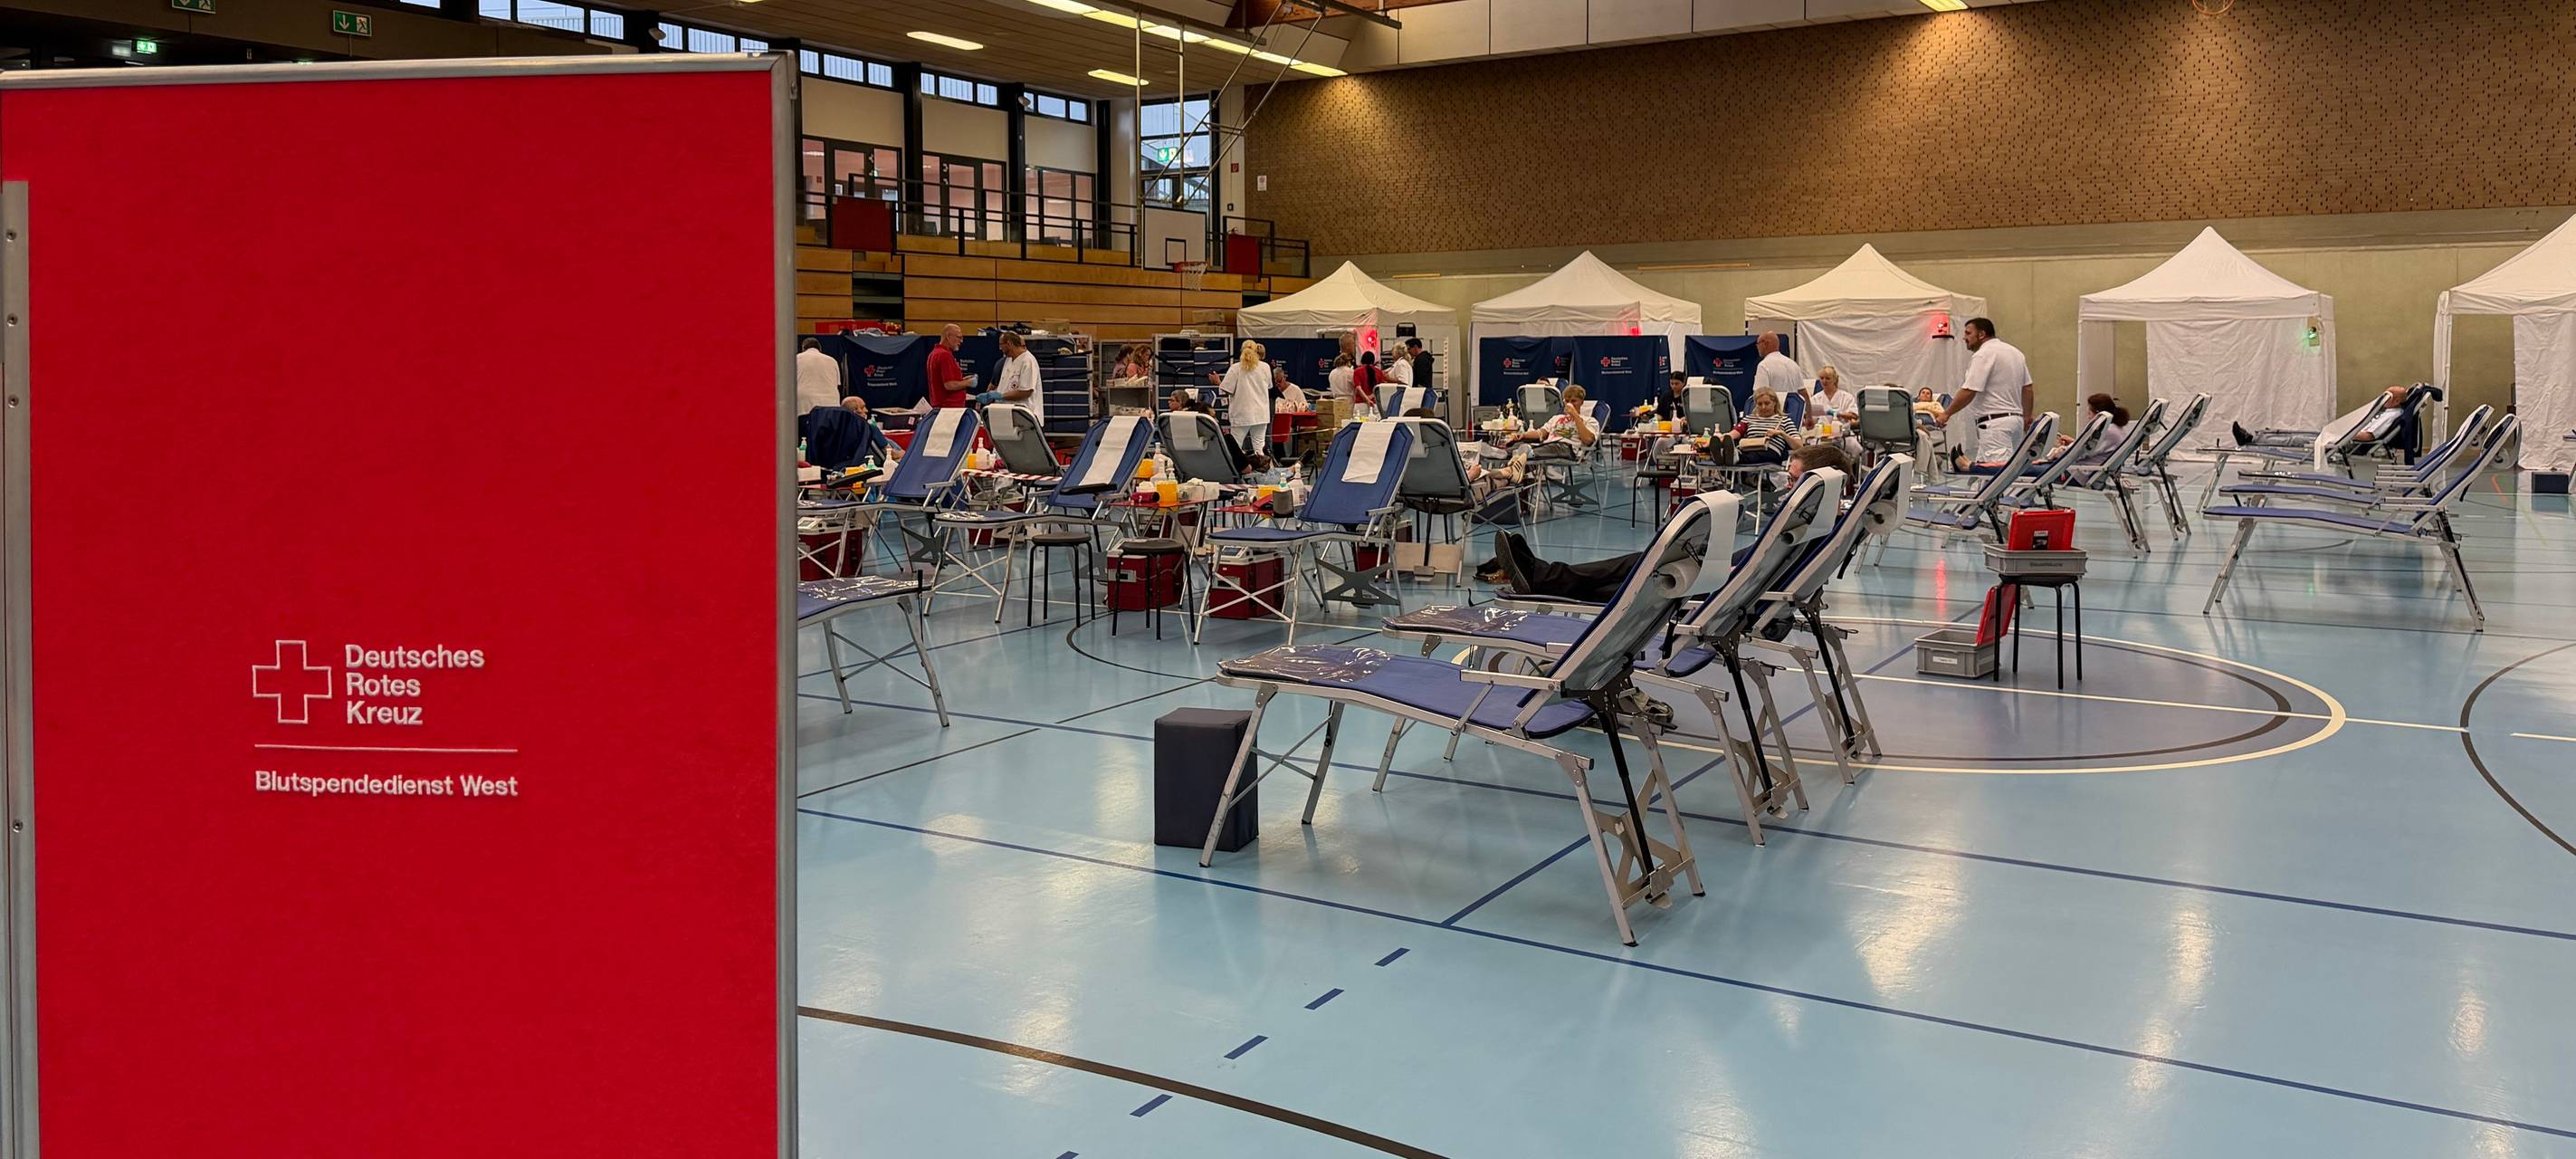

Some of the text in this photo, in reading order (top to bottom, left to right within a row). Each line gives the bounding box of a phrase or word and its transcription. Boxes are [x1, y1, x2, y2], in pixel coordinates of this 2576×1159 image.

[345, 644, 485, 668] Deutsches
[346, 672, 421, 697] Rotes
[347, 700, 424, 725] Kreuz
[255, 770, 519, 797] Blutspendedienst West
